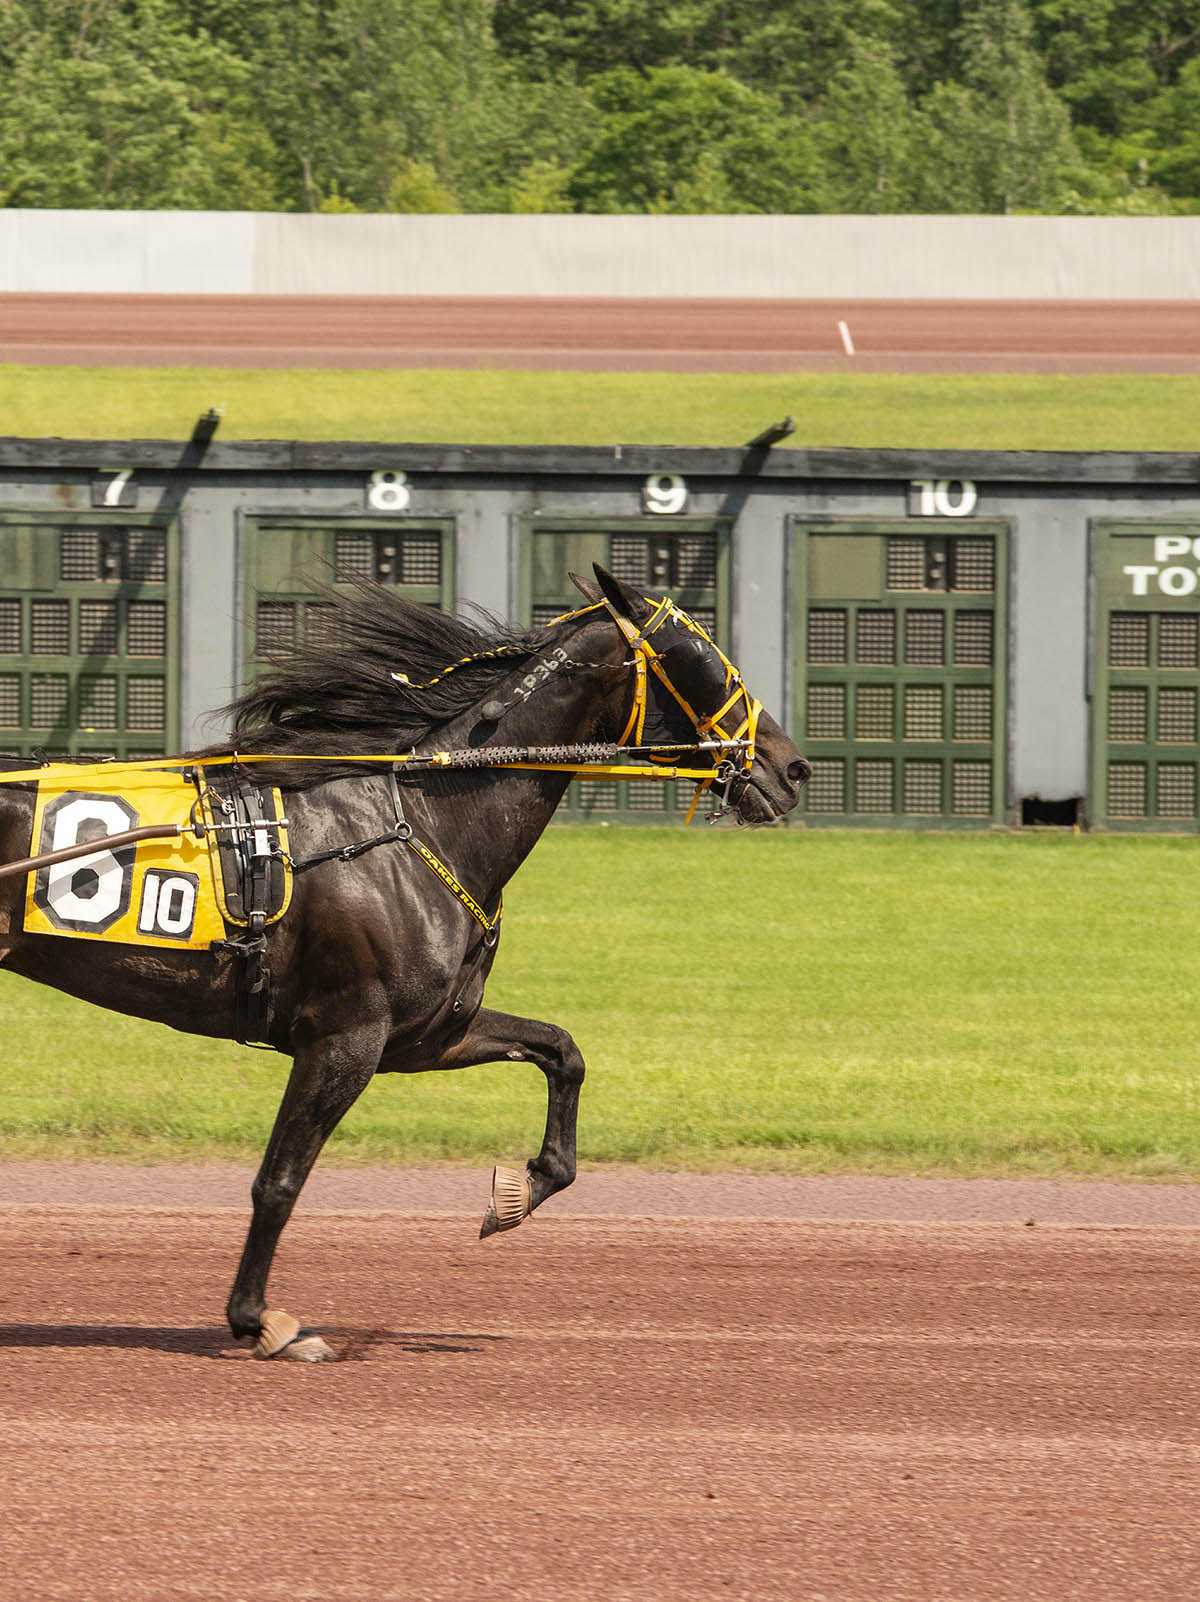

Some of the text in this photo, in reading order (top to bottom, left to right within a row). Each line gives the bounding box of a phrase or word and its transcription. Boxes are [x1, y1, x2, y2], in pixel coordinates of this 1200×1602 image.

[98, 468, 135, 507] 7
[369, 470, 411, 511] 8
[646, 475, 687, 514] 9
[910, 479, 977, 517] 10
[1123, 565, 1200, 597] TO
[46, 799, 131, 924] 8
[420, 847, 460, 893] OAKES
[139, 873, 196, 934] 10
